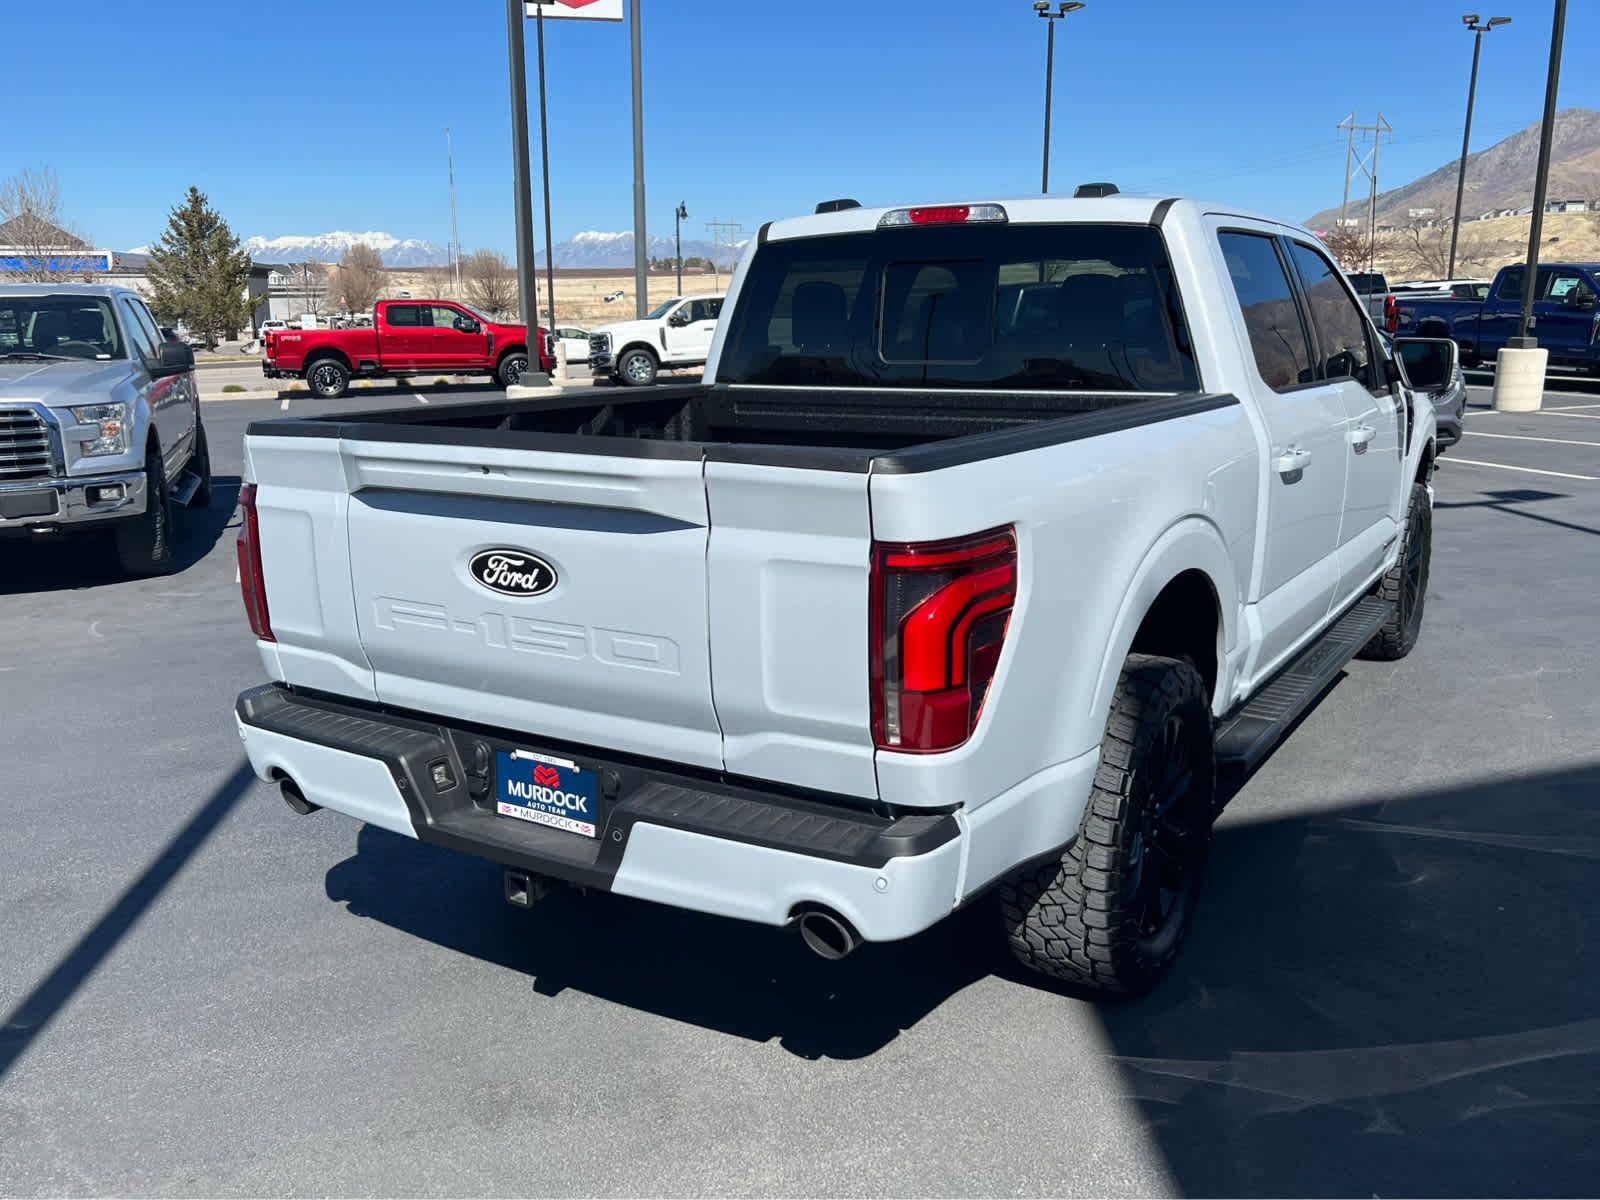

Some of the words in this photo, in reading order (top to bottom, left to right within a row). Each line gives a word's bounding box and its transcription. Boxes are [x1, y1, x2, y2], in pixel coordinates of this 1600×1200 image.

[482, 554, 540, 591] Ford
[372, 595, 681, 676] F-150
[507, 778, 588, 814] MURDOCK
[526, 800, 546, 811] AUTO
[548, 805, 566, 816] TEAM
[519, 808, 573, 829] MURDOCK
